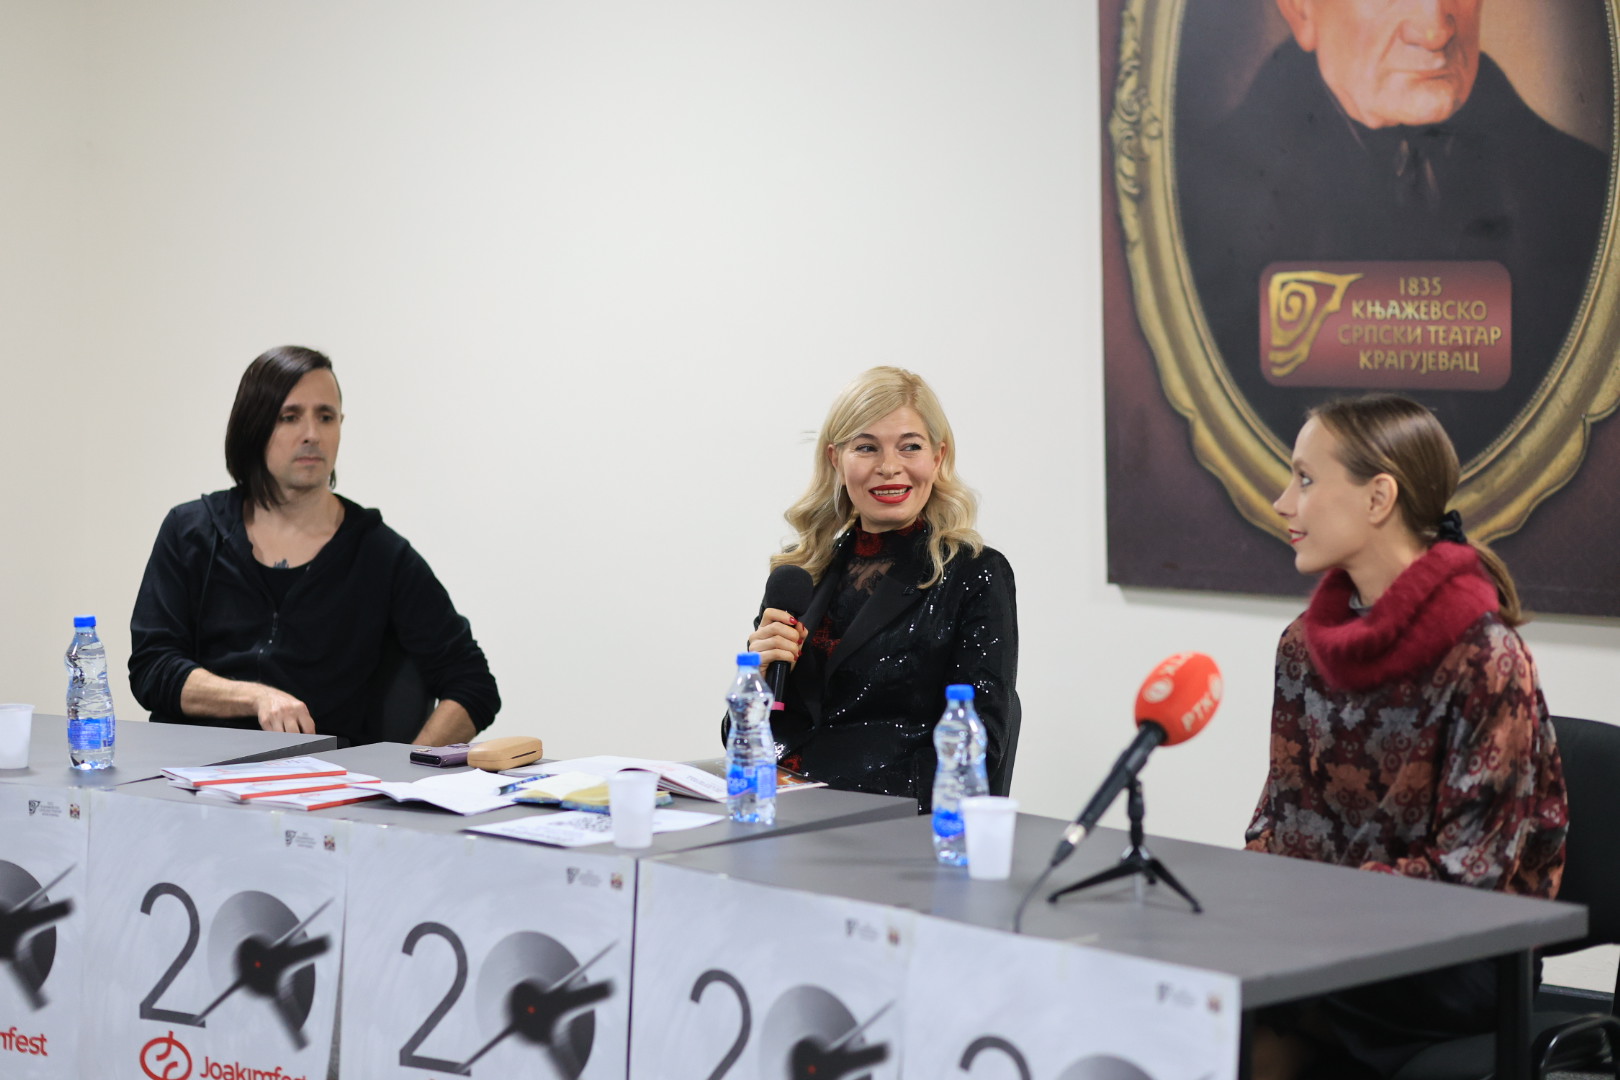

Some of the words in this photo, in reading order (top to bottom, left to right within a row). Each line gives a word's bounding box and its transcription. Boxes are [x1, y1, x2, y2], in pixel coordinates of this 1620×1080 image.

[1399, 276, 1442, 296] 1835
[1351, 300, 1488, 321] КЊАЖЕВСКО
[1337, 325, 1422, 345] СРПСКИ
[1427, 325, 1502, 346] ТЕАТАР
[1359, 350, 1480, 374] КРАГУЈЕВАЦ
